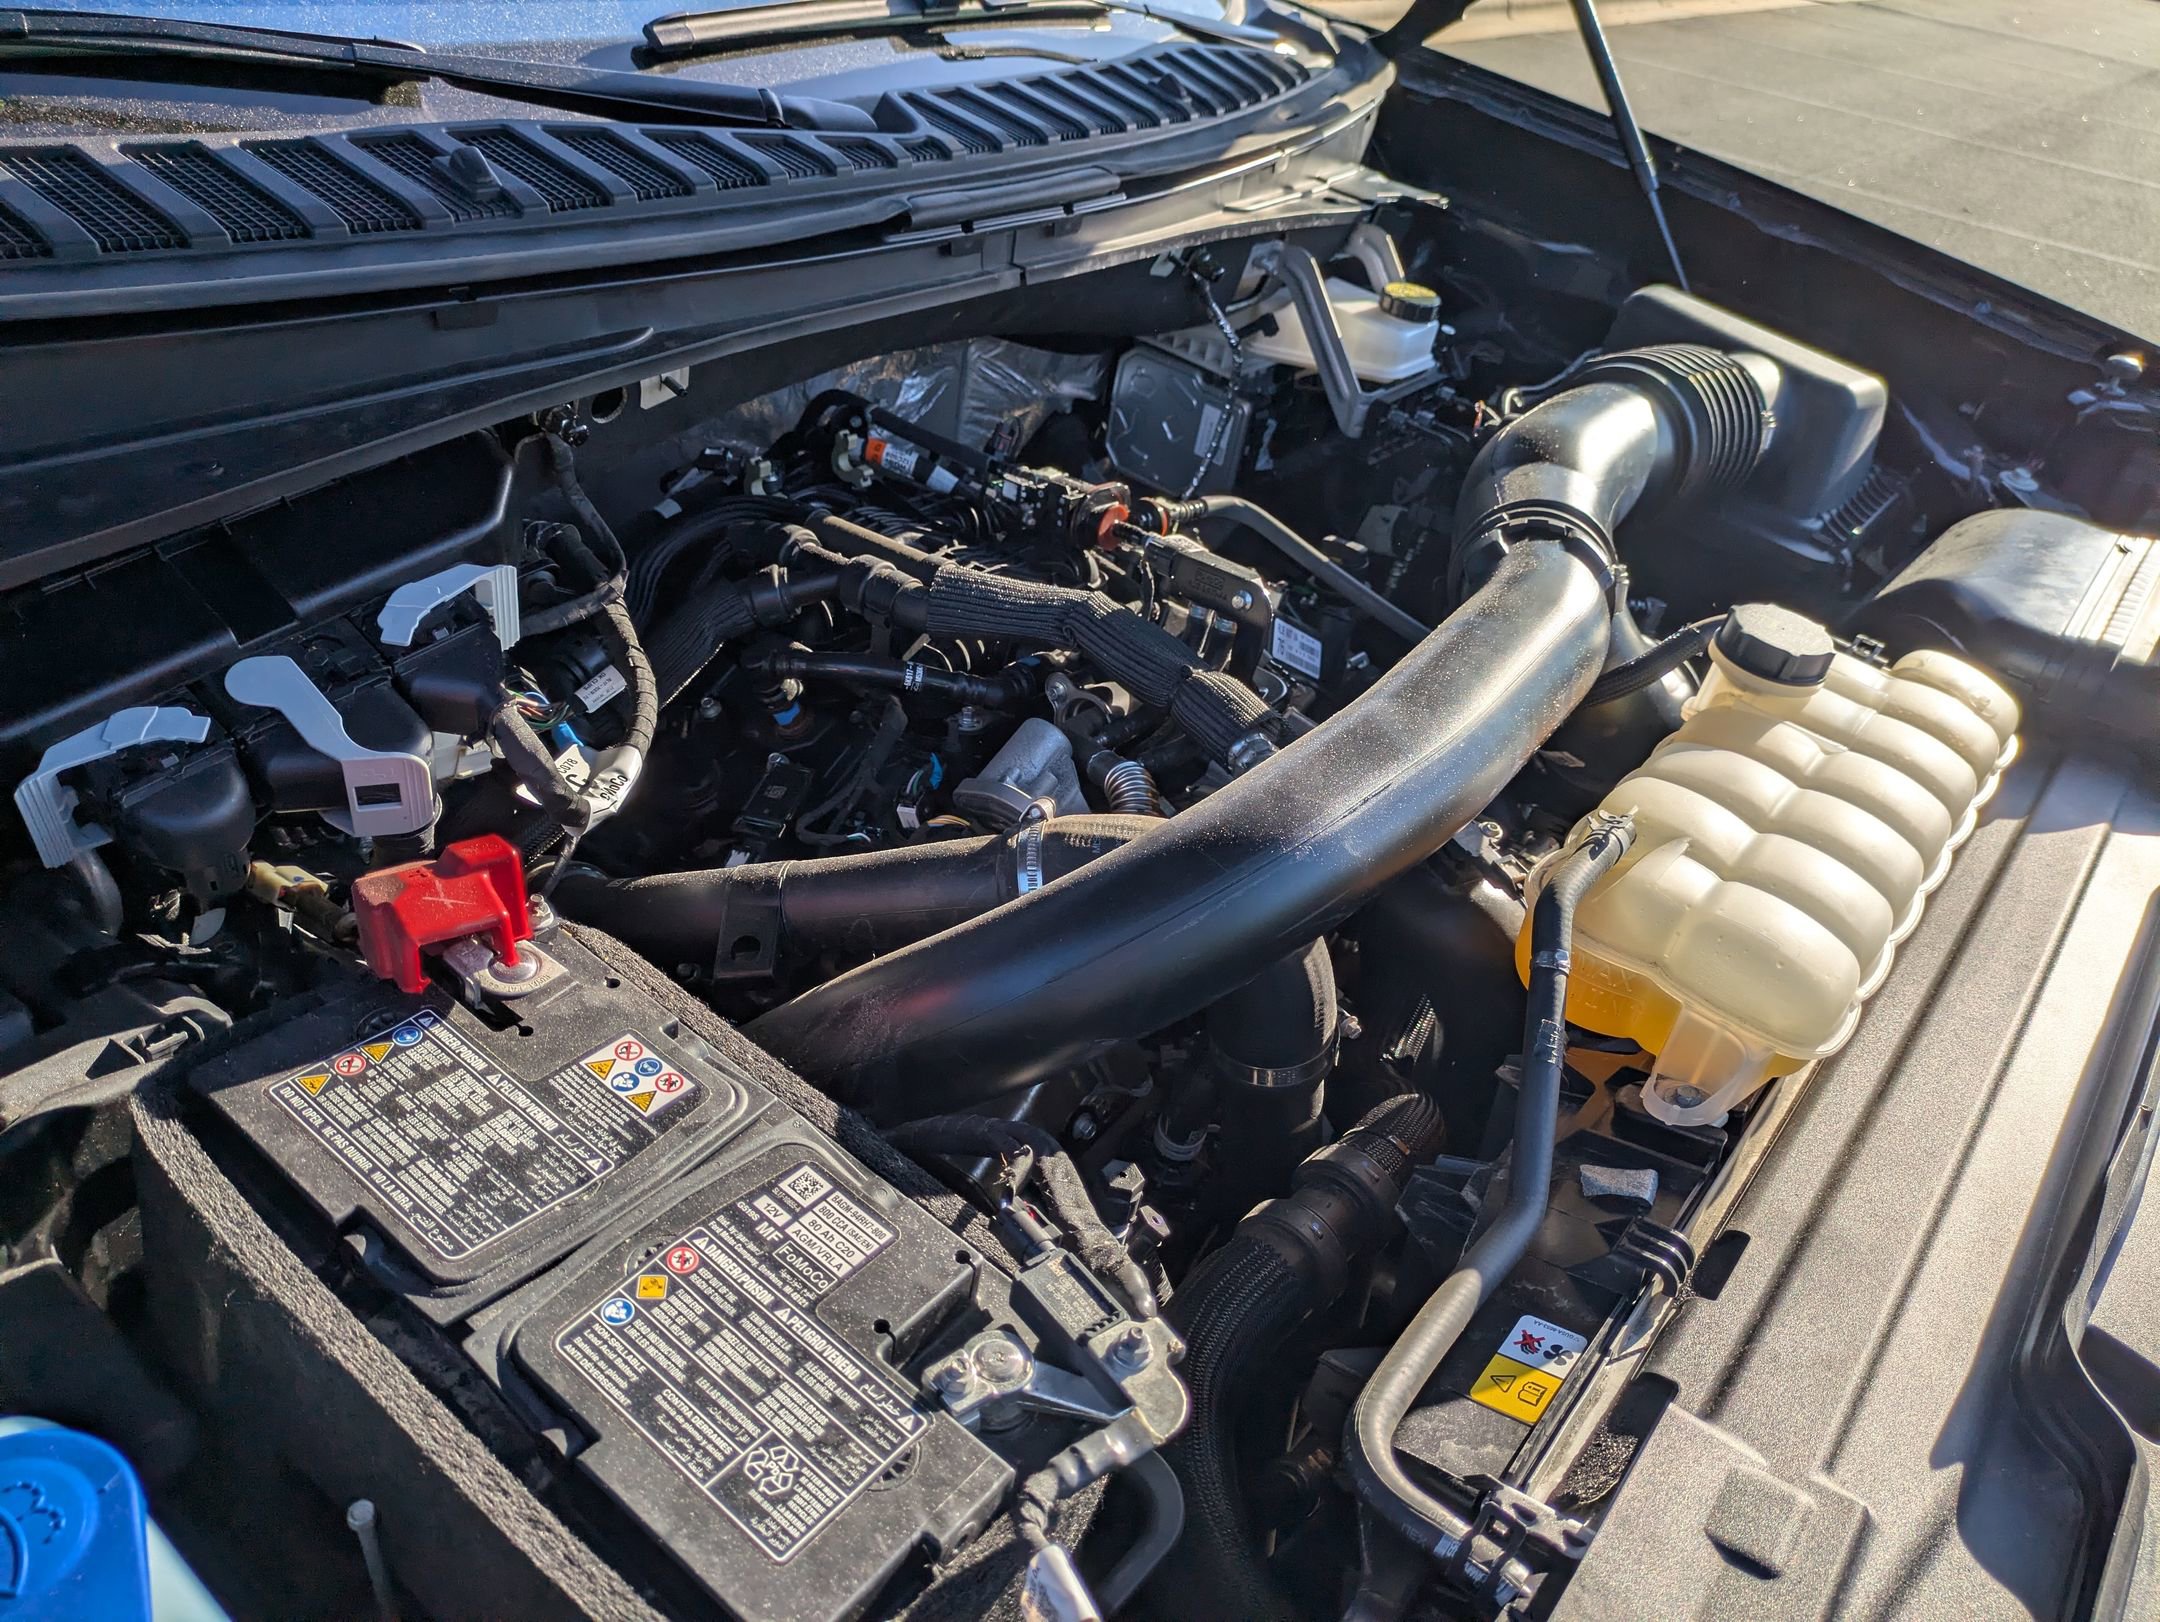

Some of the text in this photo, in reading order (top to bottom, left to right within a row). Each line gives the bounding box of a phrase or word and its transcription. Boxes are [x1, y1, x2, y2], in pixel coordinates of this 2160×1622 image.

[396, 1052, 416, 1067] CAUSE
[412, 1044, 442, 1067] EXPLOSIVE
[420, 1039, 442, 1056] SHIELD
[427, 1022, 489, 1071] DANGER/POISON
[279, 1086, 327, 1128] DO NOT OPEN.
[366, 1080, 388, 1097] FLAMES
[437, 1076, 469, 1101] EXPLOSIFS
[445, 1072, 461, 1083] LES
[468, 1092, 484, 1103] LES
[477, 1100, 493, 1111] GAZ
[495, 1079, 560, 1131] PELIGRO/VENENO
[486, 1118, 521, 1146] EXPLOSIVOS
[501, 1108, 539, 1138] PROTEJA LOS
[507, 1125, 524, 1137] LOS
[516, 1133, 539, 1150] GASES
[321, 1125, 376, 1173] NE PAS OUVRIR.
[494, 1138, 517, 1155] CAUSAR
[369, 1171, 417, 1212] NO LA ABRA.
[735, 1200, 760, 1221] G519S
[761, 1201, 783, 1220] 12V
[755, 1221, 783, 1245] MF
[817, 1205, 873, 1251] 800 CCA (SAE/EN)
[830, 1193, 887, 1241] BAGM-94RH7-800
[791, 1226, 844, 1272] AGM/VRLA
[806, 1218, 856, 1259] 80 Ah C20
[703, 1242, 775, 1306] DANGER/POISON
[707, 1220, 808, 1308] Ford Motor Company, Dearborn, MI 48121
[778, 1243, 831, 1290] FoMoCo
[675, 1288, 705, 1315] FLUSH EYES
[688, 1272, 708, 1290] REACH
[703, 1286, 715, 1296] OF
[696, 1266, 738, 1303] KEEP OUT OF THE
[650, 1306, 674, 1328] MEDICAL
[669, 1323, 685, 1337] HELP
[667, 1294, 699, 1323] IMMEDIATELY
[591, 1321, 647, 1374] NON-SPILLABLE
[632, 1318, 689, 1370] READ INSTRUCTIONS.
[738, 1316, 763, 1338] PORTÉE
[756, 1333, 770, 1346] DES
[746, 1310, 792, 1351] TENIR HORS DE LA
[785, 1314, 861, 1382] PELIGRO/VENENO
[573, 1335, 630, 1390] Batterie au plomb
[583, 1328, 639, 1383] Lead Acid Battery
[623, 1324, 688, 1384] LIRE LES INSTRUCTIONS.
[563, 1342, 633, 1408] ANTI DÉVERSEMENT
[794, 1367, 808, 1379] DE
[802, 1373, 817, 1386] LOS
[803, 1359, 861, 1411] ALÉJESE DEL ALCANCE
[661, 1387, 733, 1455] CONTRA DERRAMES
[694, 1376, 763, 1438] LEA LAS INSTRUCCIONES.
[754, 1401, 770, 1415] CON
[764, 1410, 776, 1420] EL
[771, 1387, 815, 1427] INMEDIATAMENTE
[809, 1422, 825, 1436] CON
[776, 1406, 797, 1426] ACUDA
[779, 1381, 829, 1426] ENJUAGUE LOS OJOS
[674, 1413, 686, 1424] de
[681, 1420, 704, 1442] plomo
[699, 1438, 708, 1447] y
[704, 1442, 726, 1462] ácido
[764, 1459, 782, 1476] Pb
[800, 1466, 839, 1501] BATTERY MUST
[776, 1503, 786, 1513] LA
[793, 1483, 826, 1514] LA BATTERIE
[799, 1475, 833, 1507] BE RECYCLED
